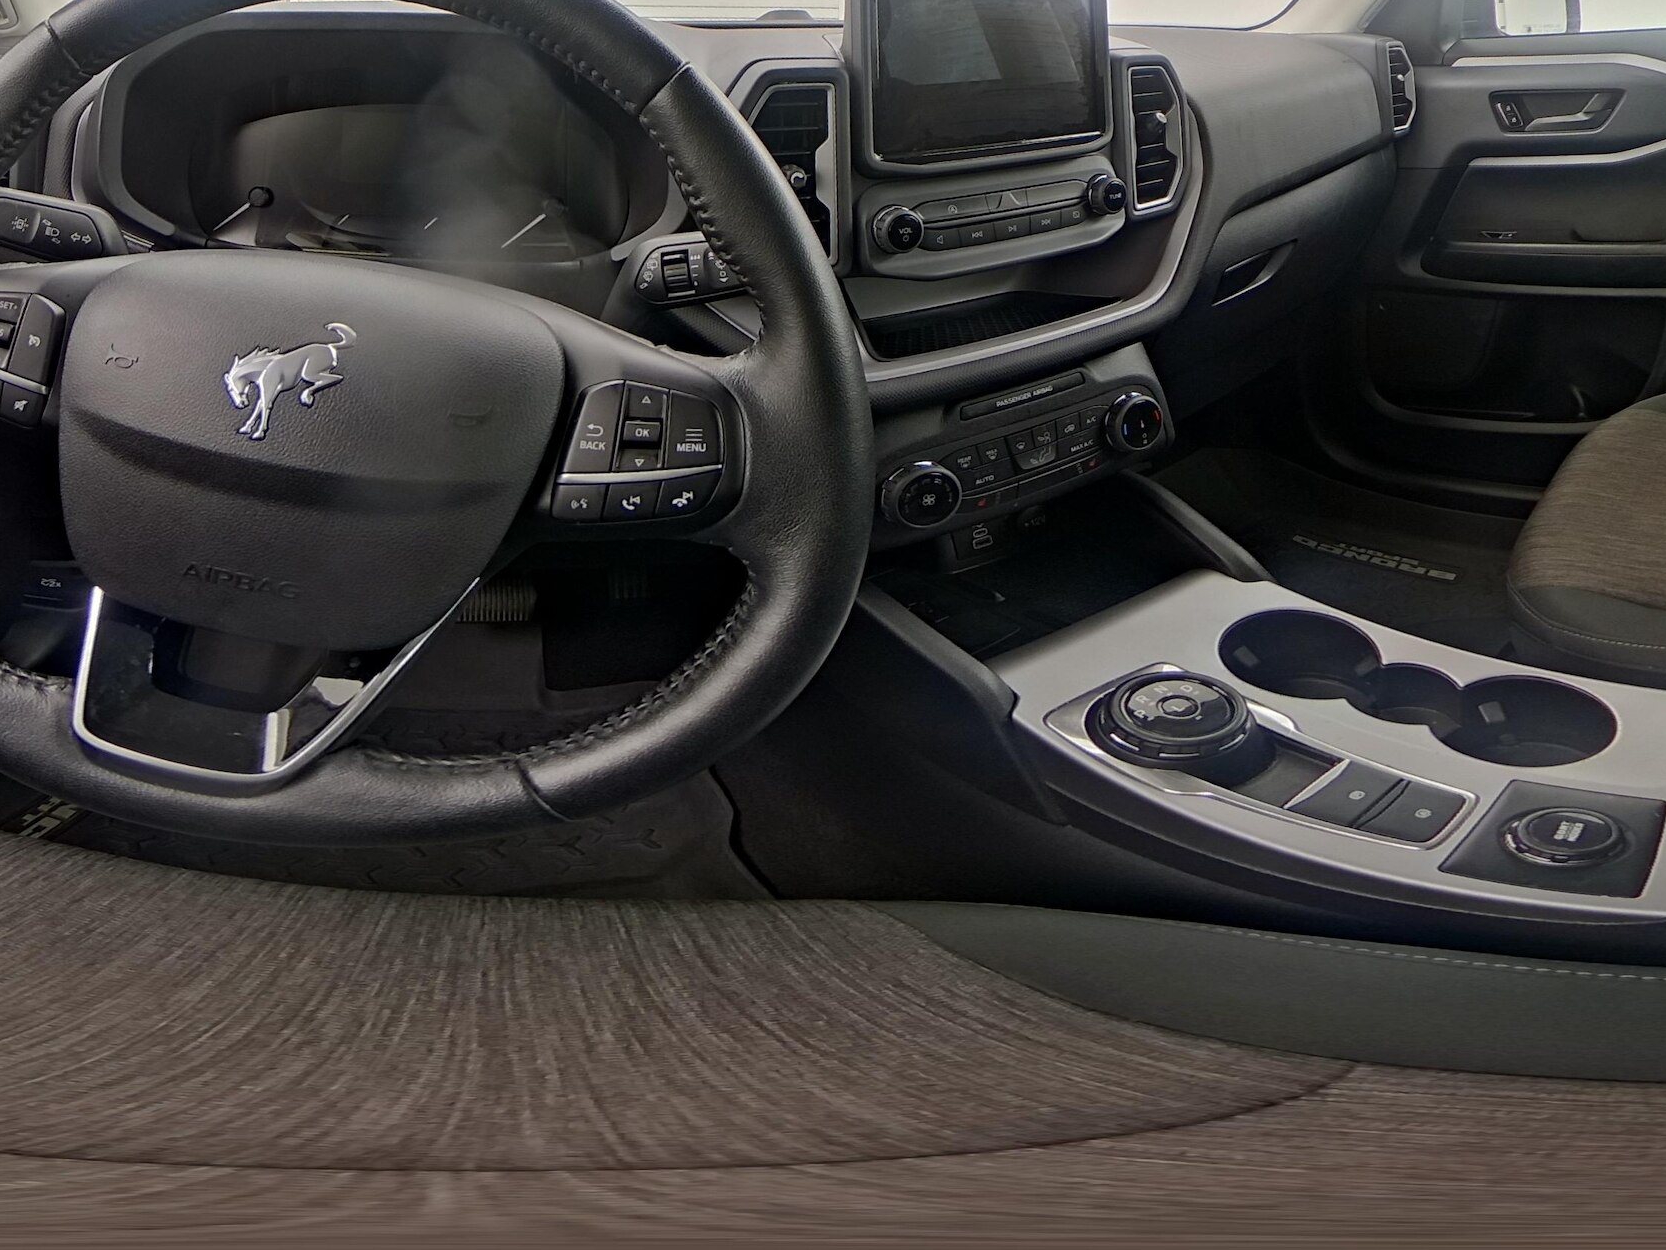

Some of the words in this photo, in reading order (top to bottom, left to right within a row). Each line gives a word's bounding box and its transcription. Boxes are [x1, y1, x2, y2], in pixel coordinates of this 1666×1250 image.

[1108, 193, 1123, 201] TUNE
[898, 227, 914, 235] VOL
[996, 391, 1032, 408] PASSENGER
[1032, 385, 1054, 397] AIRBAG
[1086, 415, 1097, 424] A/C
[635, 428, 650, 437] OK
[579, 440, 606, 450] BACK
[676, 442, 707, 452] MENU
[1070, 444, 1083, 452] MAX
[1083, 438, 1094, 448] A/C
[975, 475, 995, 485] AUTO
[1153, 685, 1168, 695] N
[1180, 684, 1193, 693] D
[1134, 694, 1150, 706] R
[1134, 709, 1147, 719] P
